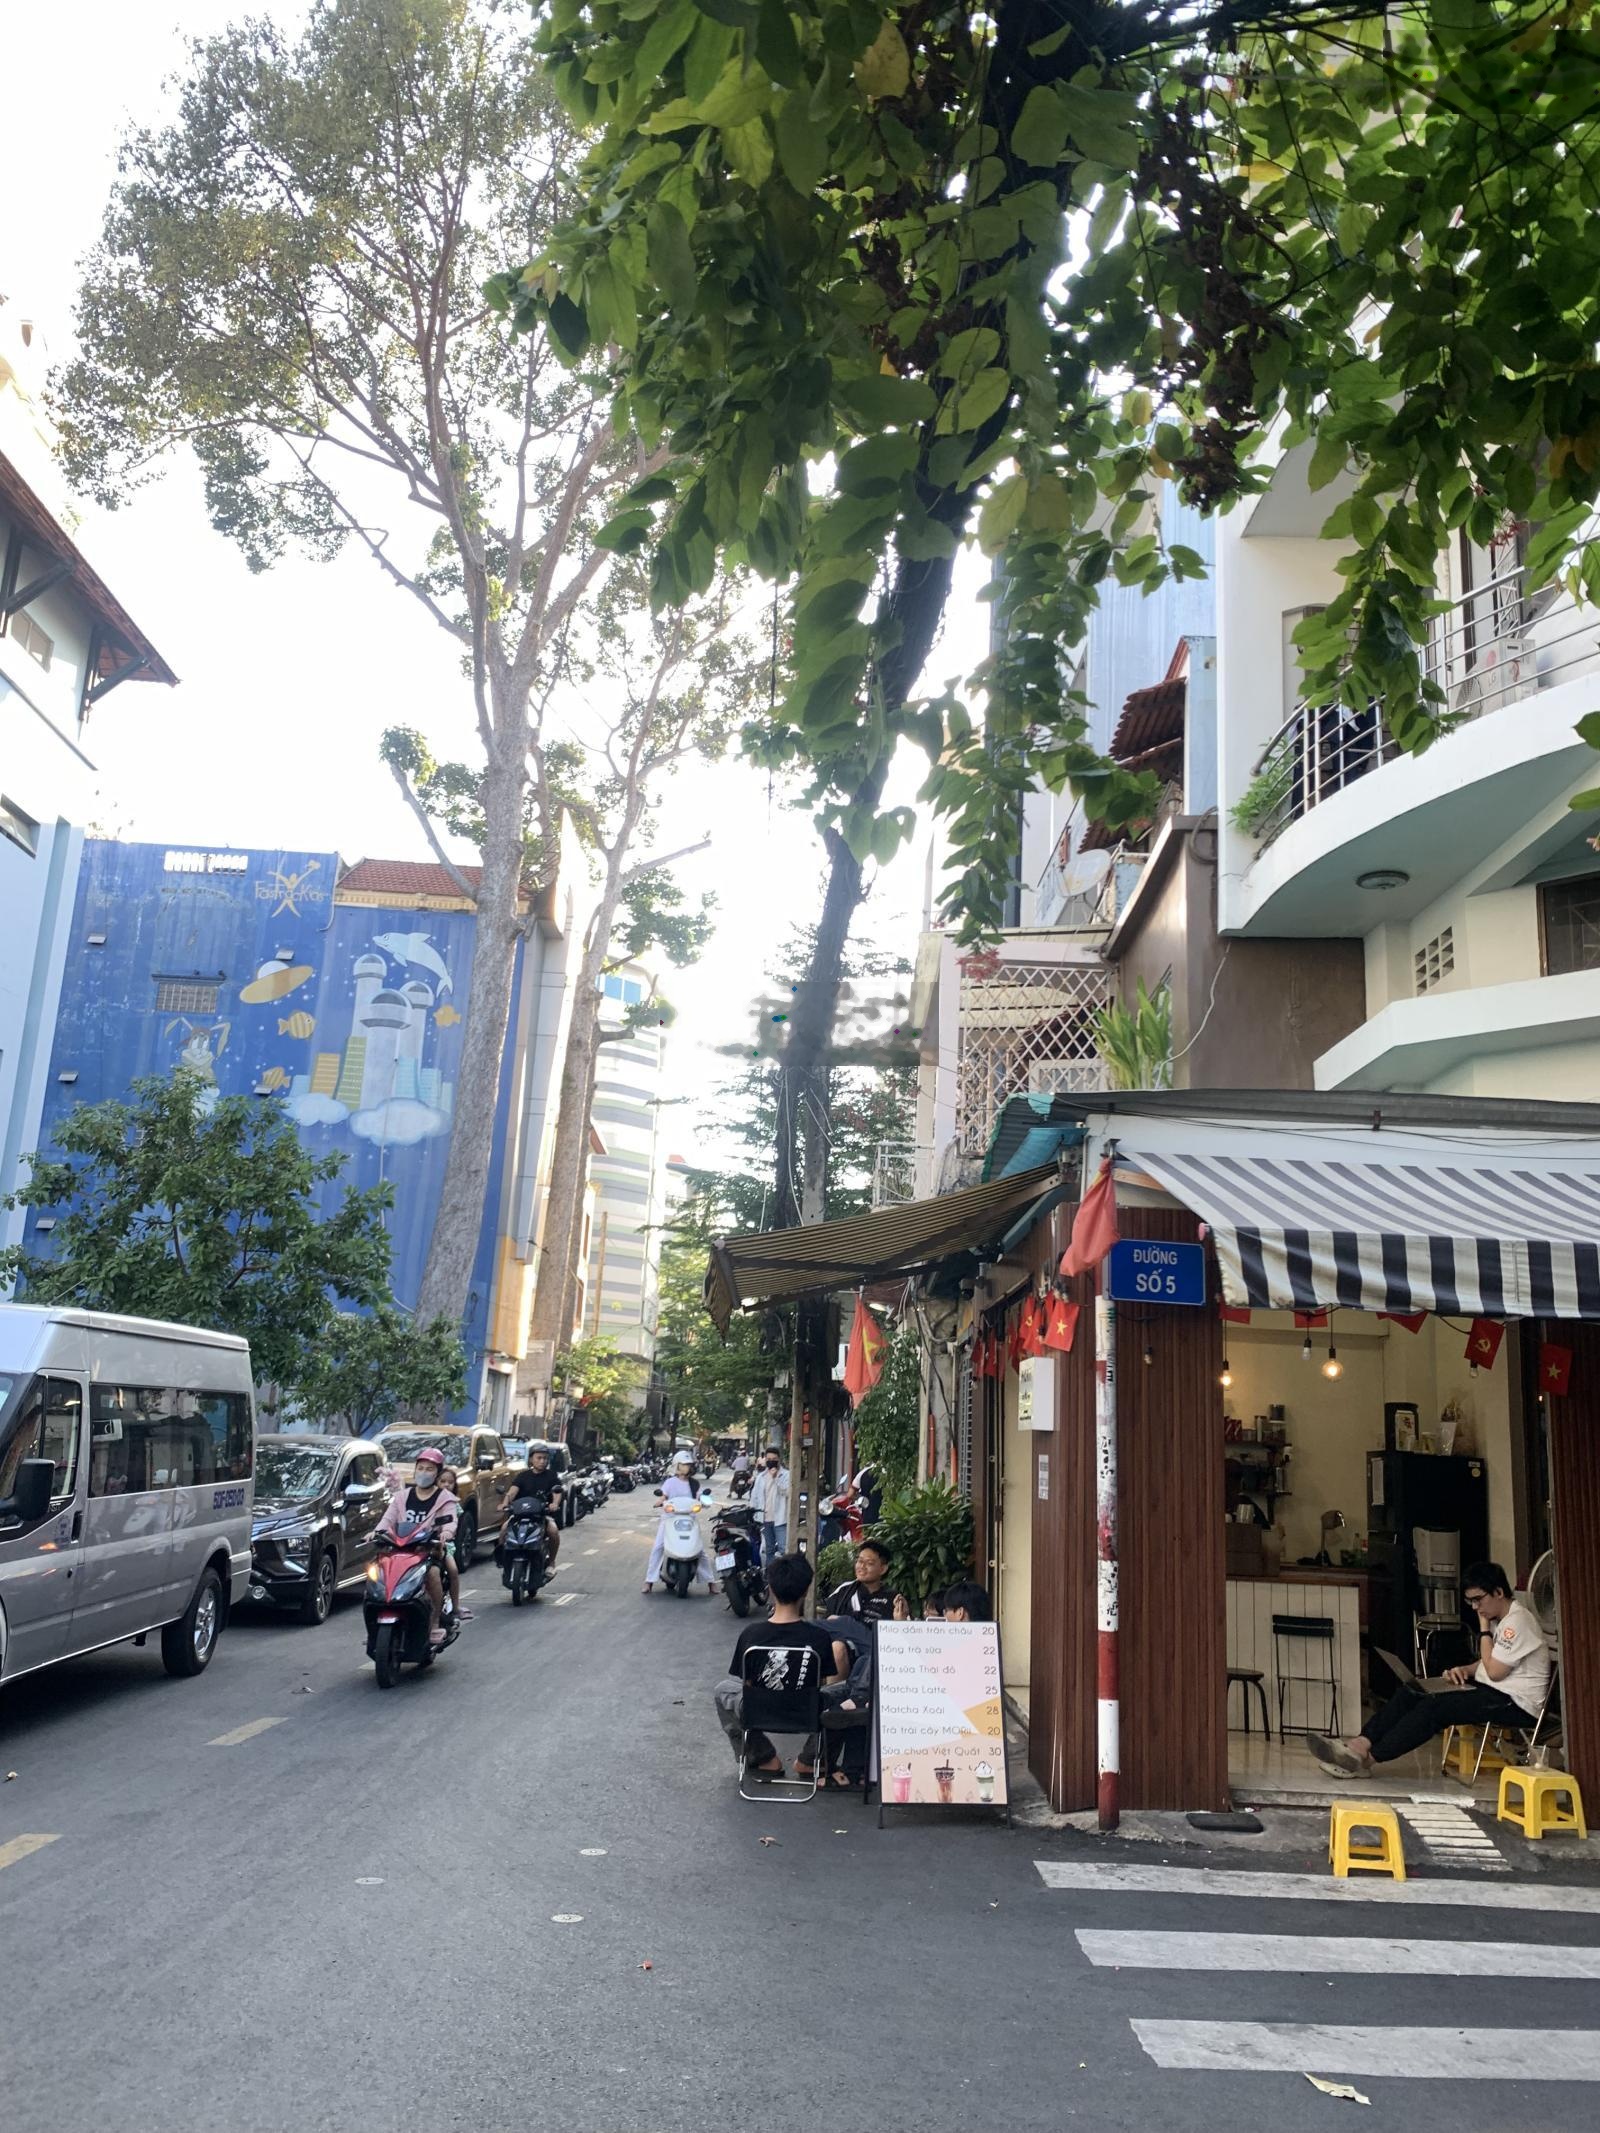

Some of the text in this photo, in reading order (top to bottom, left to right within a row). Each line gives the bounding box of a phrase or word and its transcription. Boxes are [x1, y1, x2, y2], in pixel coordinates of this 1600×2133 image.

[1133, 1245, 1178, 1265] ĐƯỜNG
[1135, 1268, 1176, 1294] SỐ 5
[879, 1625, 899, 1634] Milo
[982, 1627, 995, 1636] 20
[983, 1646, 996, 1655] 22
[984, 1666, 997, 1675] 22
[881, 1685, 998, 1695] Matcha Latte 25
[881, 1705, 919, 1714] Matcha
[986, 1706, 999, 1715] 28
[987, 1726, 1001, 1736] 20
[988, 1747, 1002, 1757] 30
